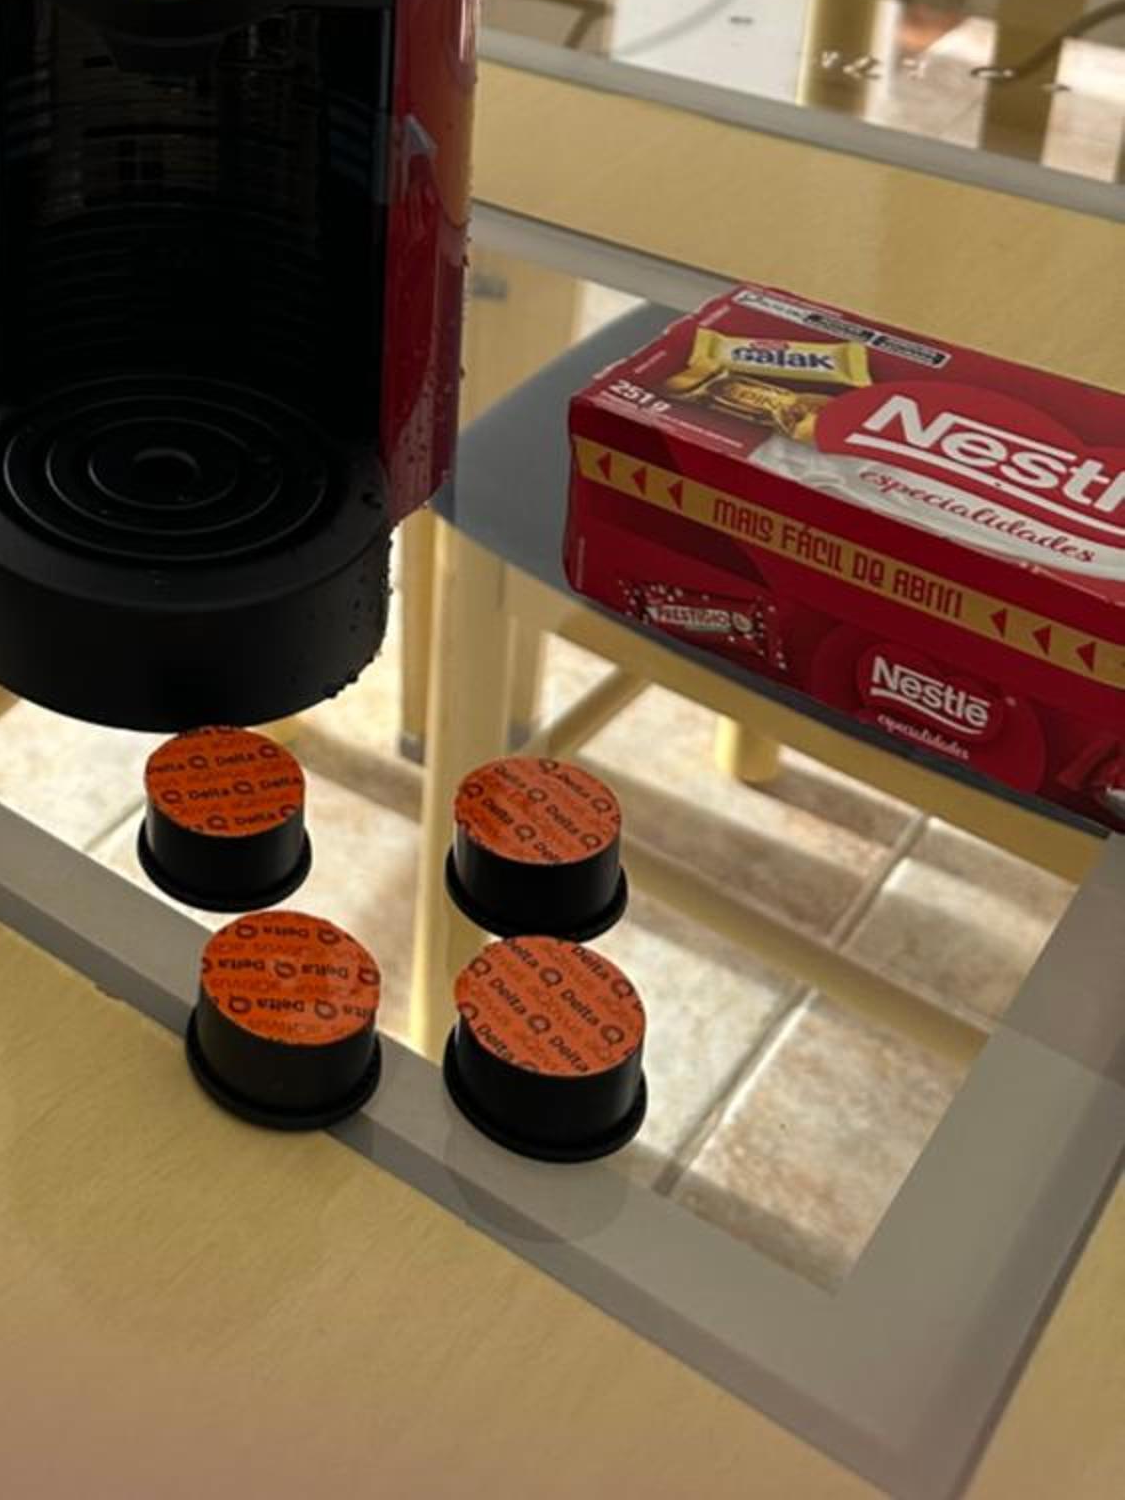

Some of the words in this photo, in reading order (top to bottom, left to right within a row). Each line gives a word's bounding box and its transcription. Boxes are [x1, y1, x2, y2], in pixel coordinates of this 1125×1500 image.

[608, 380, 651, 405] 251
[858, 468, 1097, 564] especialidades
[713, 499, 774, 543] MAIS
[781, 523, 844, 573] FÁCIL
[893, 568, 963, 618] ABRIR
[871, 656, 991, 727] Nestlé
[877, 713, 971, 760] especialidades
